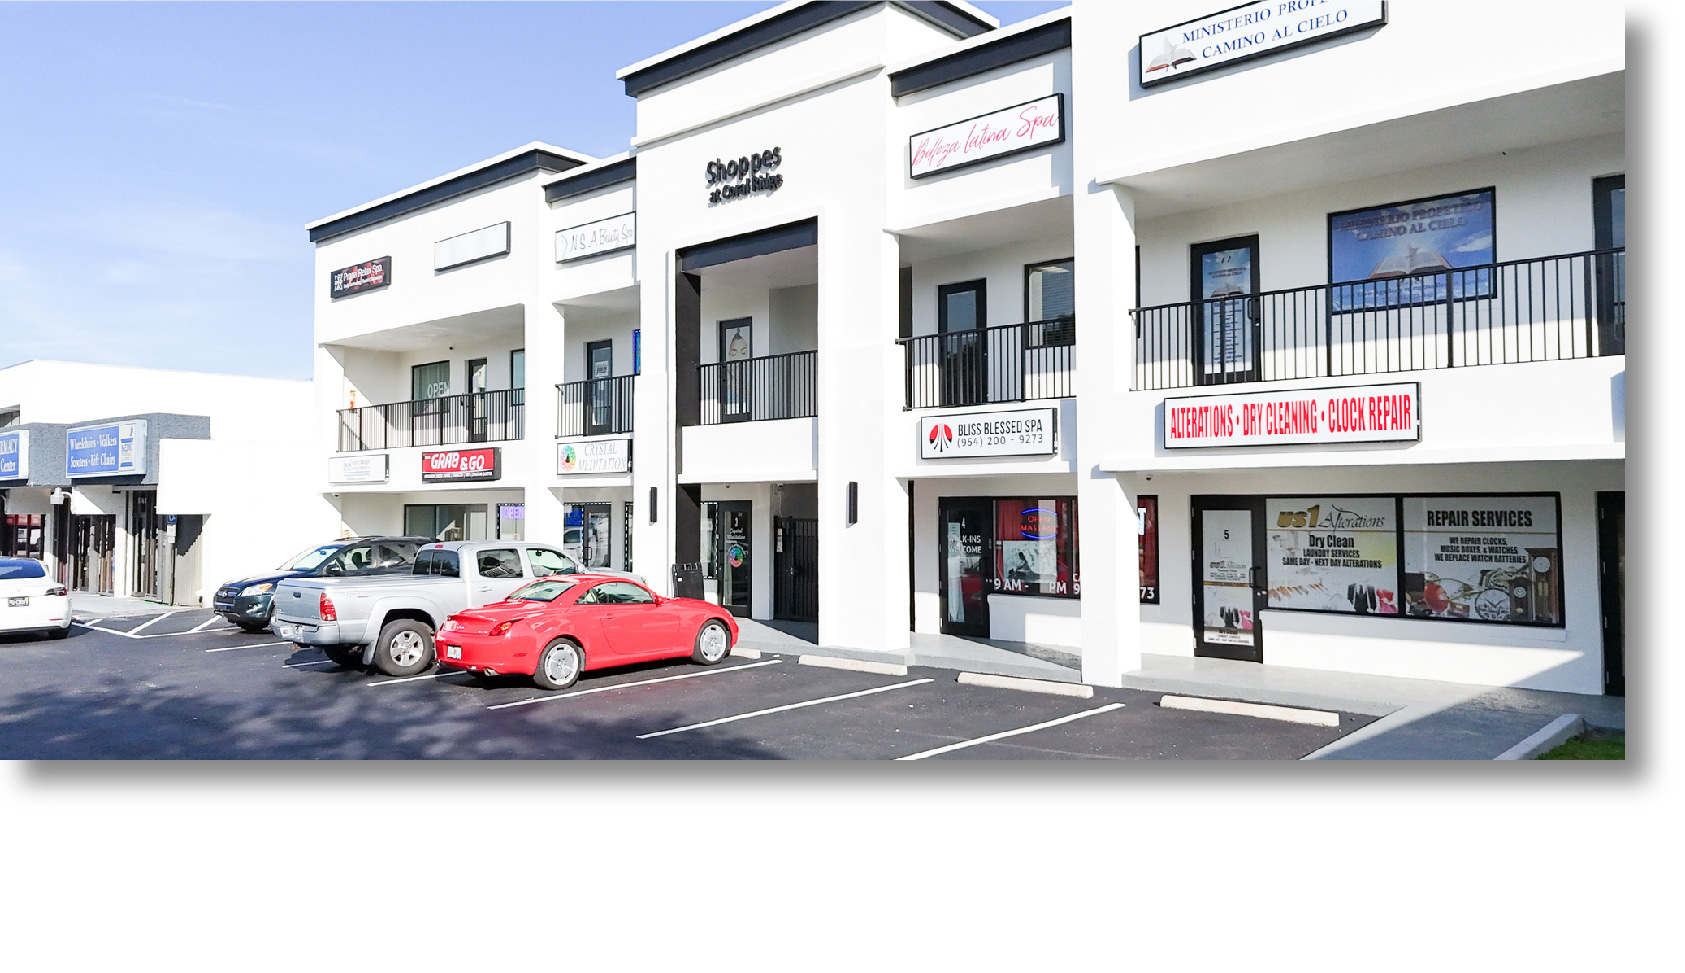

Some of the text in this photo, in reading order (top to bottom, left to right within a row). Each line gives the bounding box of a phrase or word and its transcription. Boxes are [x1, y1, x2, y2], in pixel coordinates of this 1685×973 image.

[1182, 9, 1271, 44] MINISTERIO
[1202, 9, 1348, 58] CAMINO AL CIELO
[1016, 106, 1059, 140] Spa
[707, 146, 782, 186] Shoppes
[709, 172, 783, 203] at Coral Ridge
[427, 381, 450, 399] OPEN
[1170, 394, 1412, 439] ALTERATIONS DRY CLEANING CLOCK REPAIR
[958, 419, 1043, 437] BLISS BLESSED SPA
[70, 433, 117, 450] Wheelchairs Walkers
[957, 437, 983, 449] (954)
[987, 435, 1007, 446] 200
[1018, 433, 1043, 445] 9273
[584, 443, 617, 456] CRYSTAL
[431, 452, 485, 471] GRAB & GO
[578, 457, 627, 472] MEDITATION
[1427, 510, 1533, 527] REPAIR SERVICES
[1223, 529, 1230, 540] 5
[1309, 534, 1355, 548] Dry Clean
[1449, 536, 1458, 545] WE
[1460, 537, 1481, 545] REPAIR
[1303, 548, 1360, 559] LAUNDRY SERVICES
[1441, 545, 1460, 553] MUSIC
[1282, 557, 1298, 566] SAME
[1299, 557, 1310, 566] DAY
[1315, 558, 1329, 567] NEXT
[1330, 558, 1341, 567] DAY
[1342, 559, 1382, 569] ALTERATIONS
[1434, 553, 1527, 564] WE REPLACE WATCH BATTERIES
[1003, 580, 1022, 591] AM
[1049, 582, 1067, 594] PM
